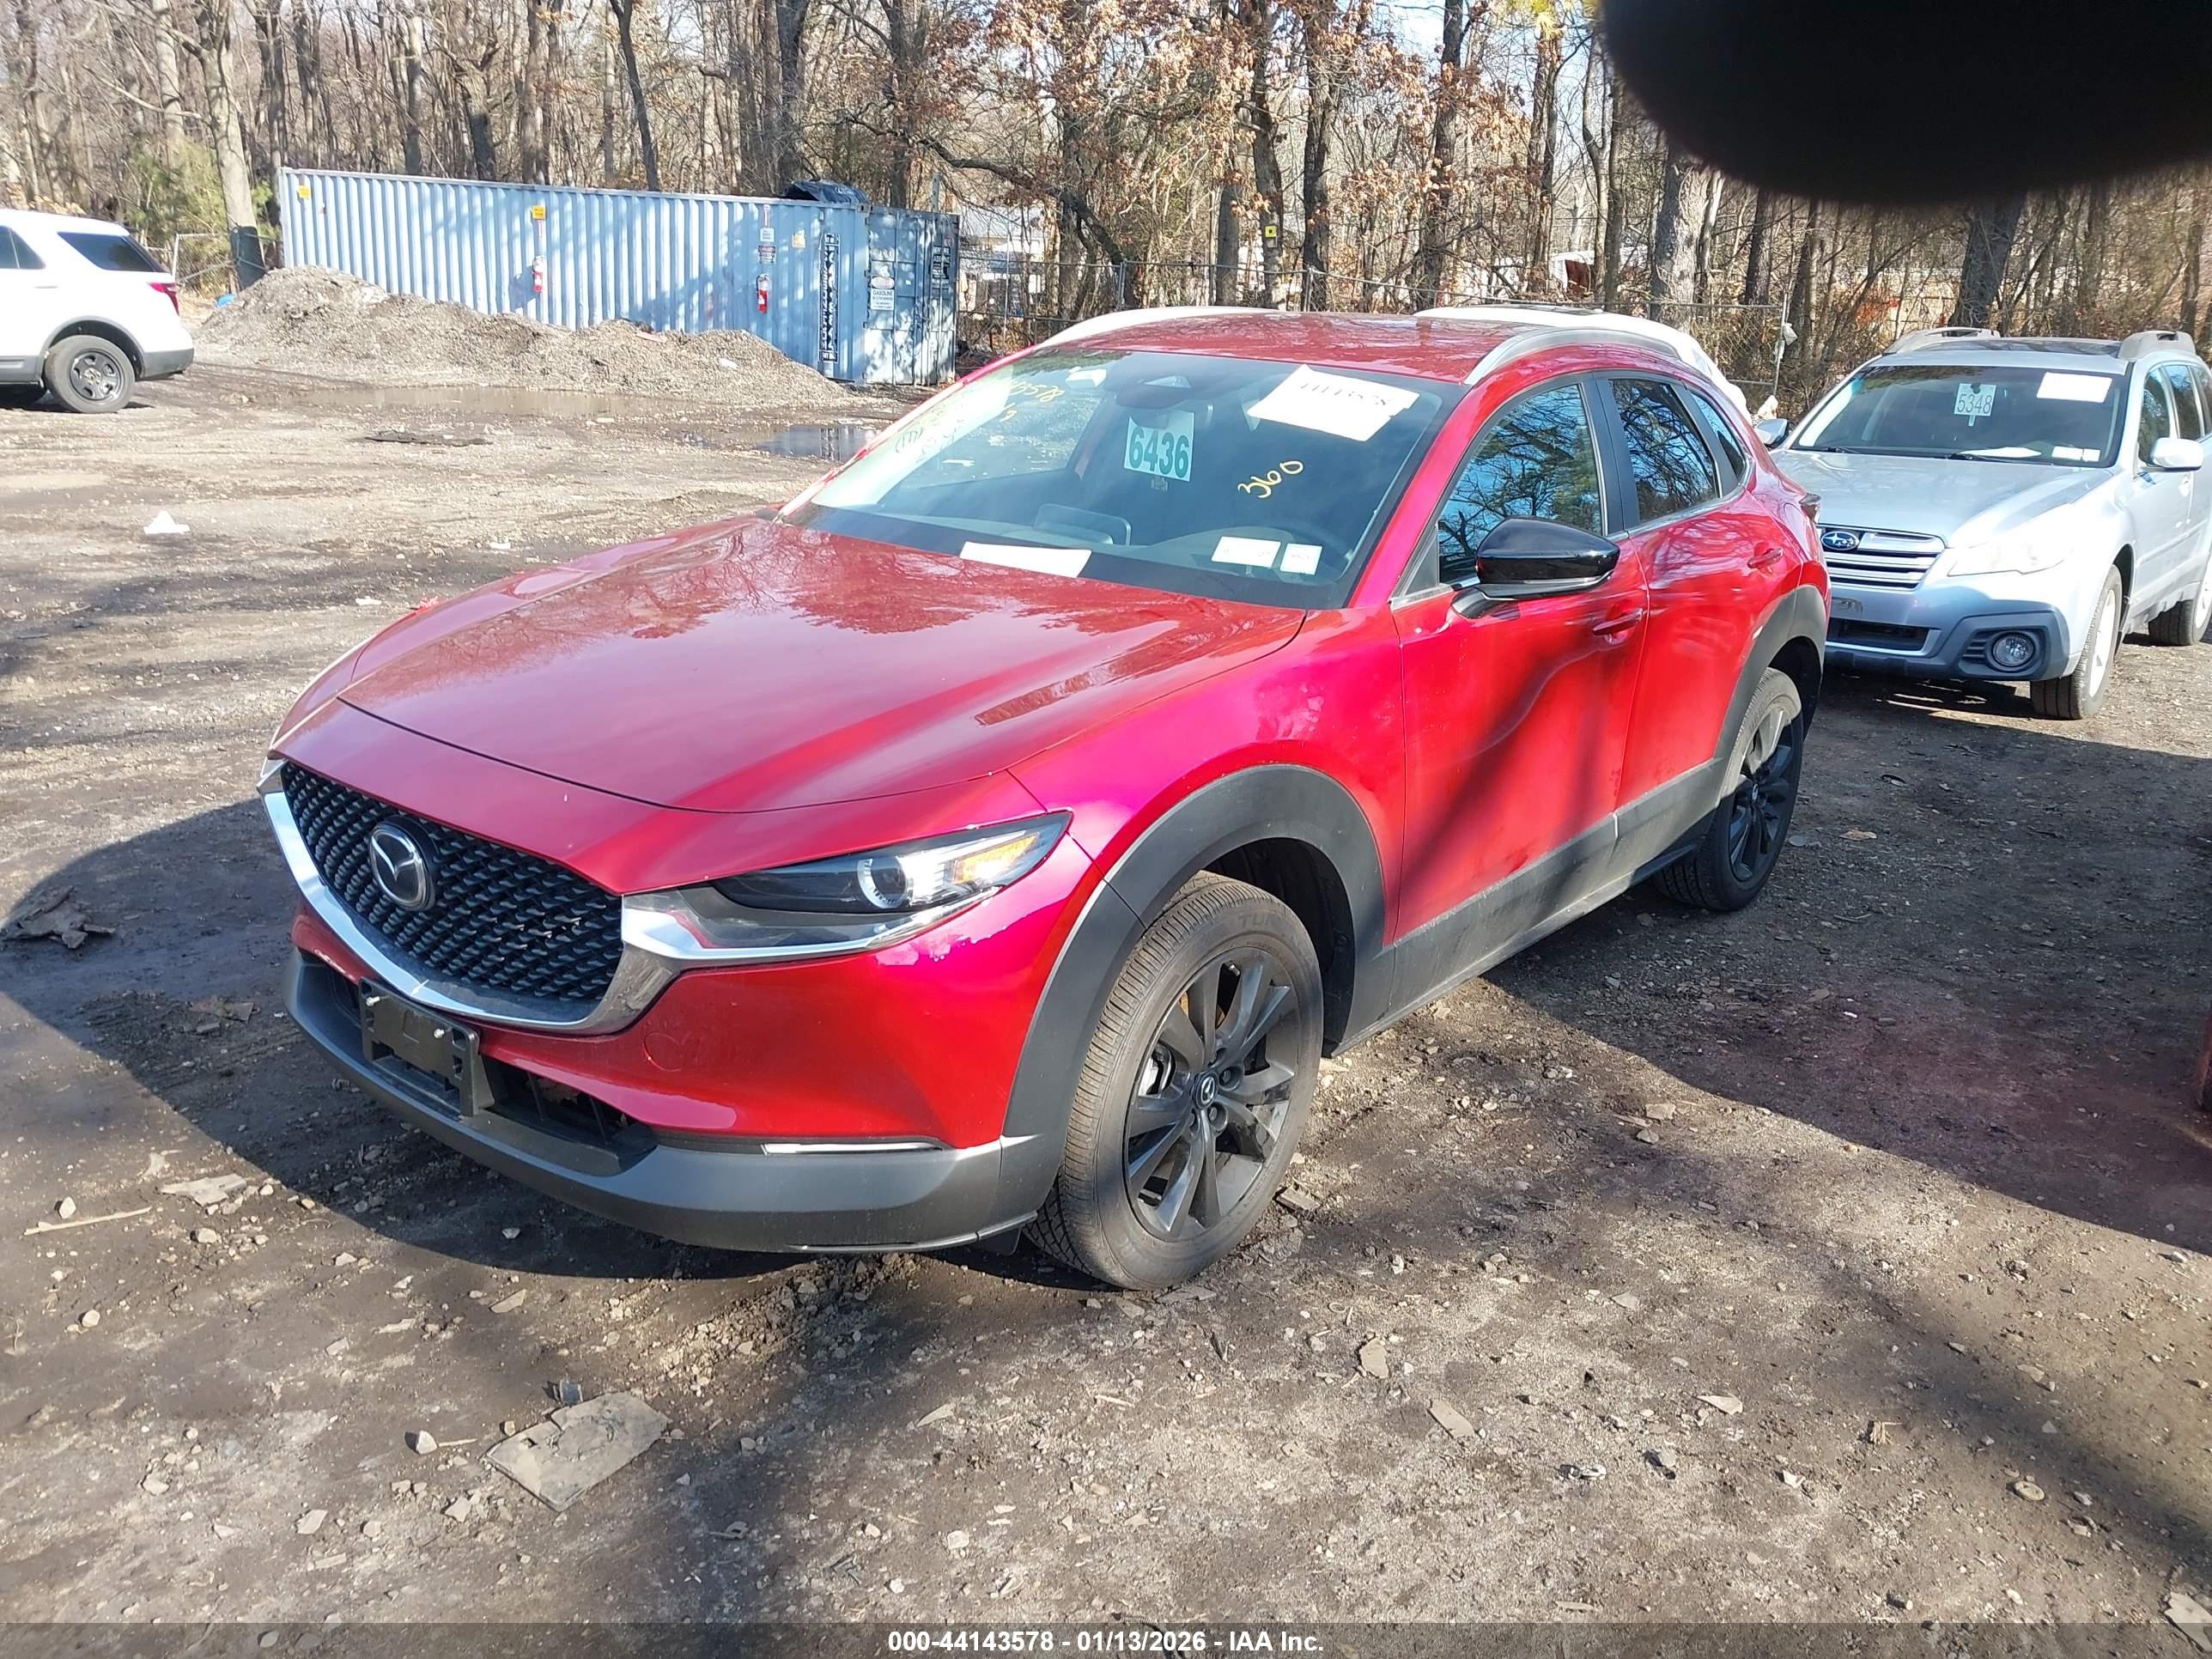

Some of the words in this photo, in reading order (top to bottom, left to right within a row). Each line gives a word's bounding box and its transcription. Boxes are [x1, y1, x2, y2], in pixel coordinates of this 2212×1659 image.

[1957, 394, 1992, 414] 5348
[1128, 427, 1190, 477] 6436
[1237, 459, 1304, 498] 360
